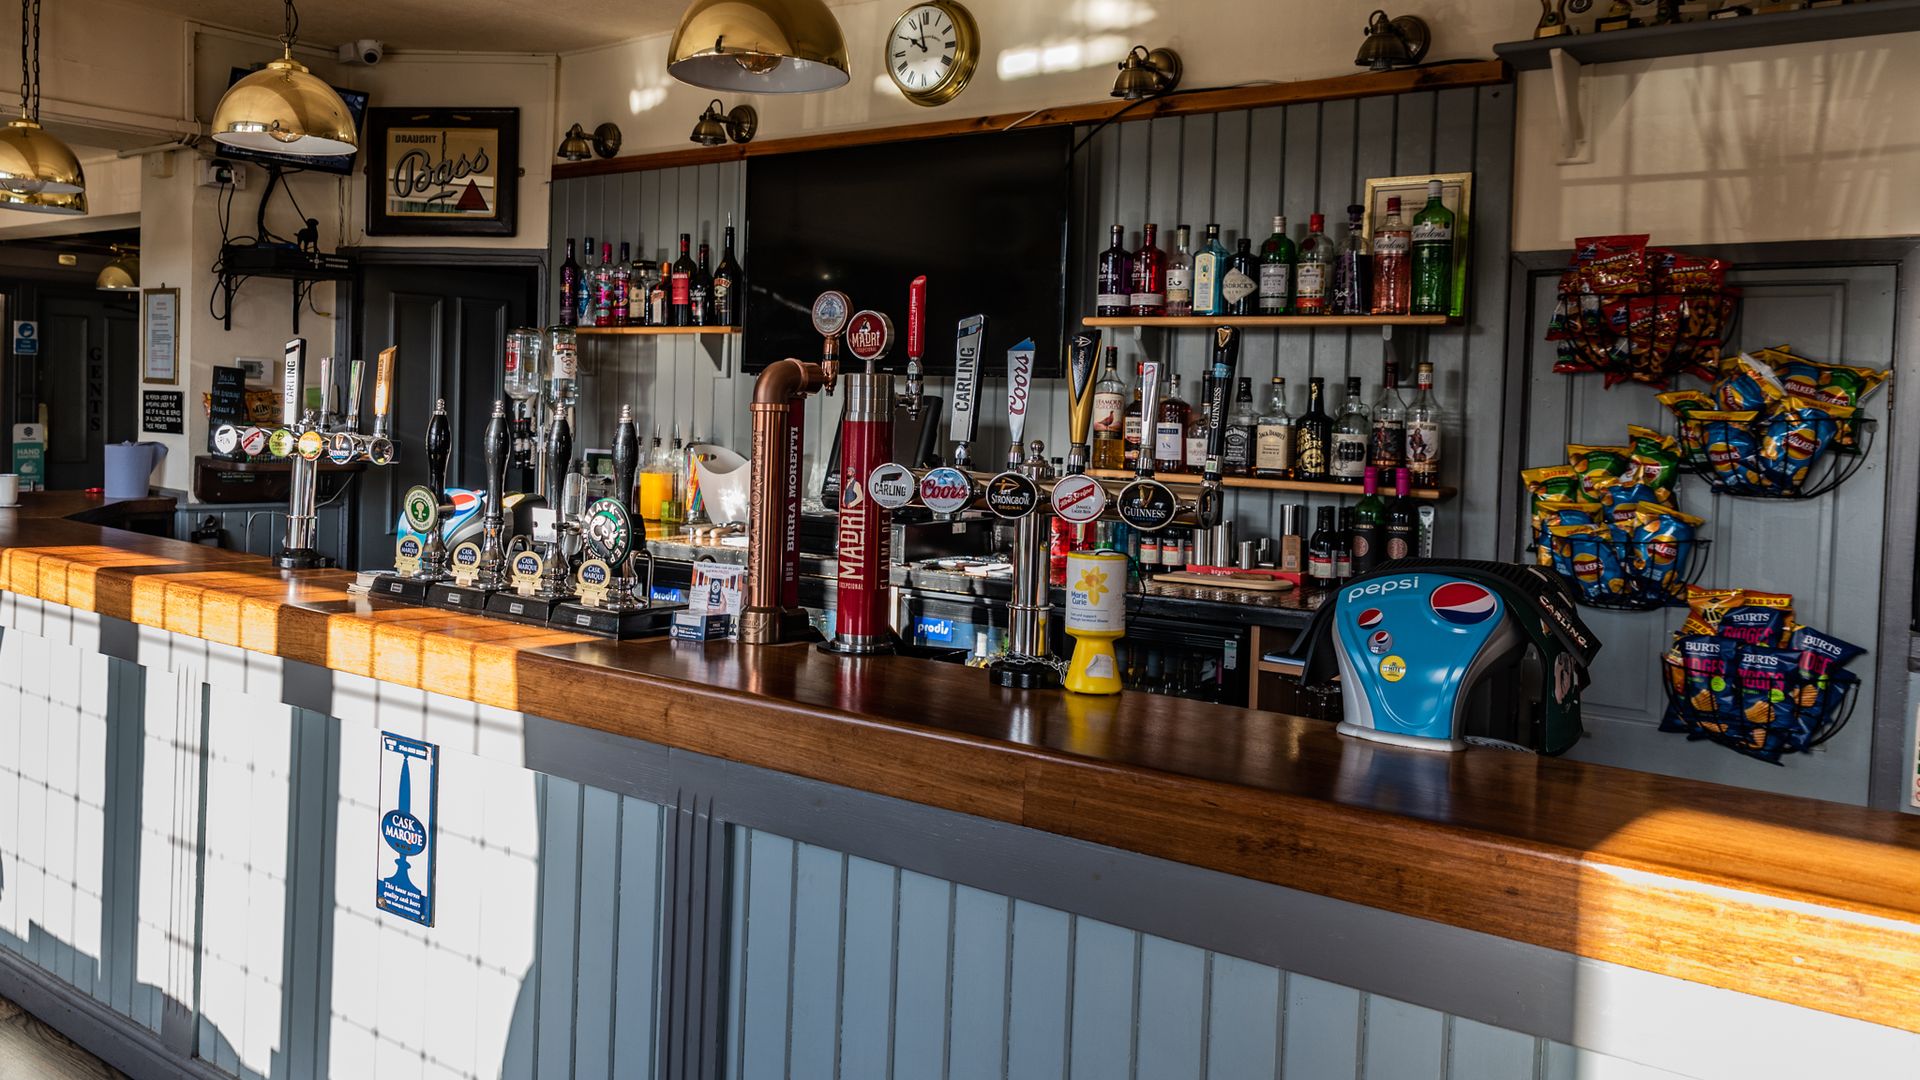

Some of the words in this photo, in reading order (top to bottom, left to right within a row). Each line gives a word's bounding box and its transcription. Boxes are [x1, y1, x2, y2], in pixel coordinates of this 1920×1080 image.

[396, 134, 437, 144] DRAUGHT
[394, 146, 489, 198] Bass
[90, 347, 102, 431] GENTS
[286, 360, 296, 404] CARLING
[954, 347, 976, 412] CARLING
[1009, 354, 1030, 416] Coors
[1210, 387, 1222, 430] GUINNESS
[788, 426, 798, 498] MORETTI
[874, 482, 906, 496] CARLING
[920, 480, 968, 498] Coors
[991, 493, 1030, 505] STRONGBOW
[1124, 506, 1167, 518] GUINNESS
[584, 501, 616, 524] BLACK
[610, 518, 627, 563] SHEEP
[787, 502, 796, 552] BIRRA
[1071, 590, 1088, 600] Marie
[1348, 576, 1419, 603] pepsi
[918, 620, 949, 634] prodis
[1540, 595, 1588, 648] CARLING
[1732, 612, 1770, 622] BURTS
[1685, 641, 1720, 653] BURTS
[1803, 634, 1842, 656] BURTS
[1742, 653, 1779, 666] BURTS
[392, 814, 414, 832] CASK
[385, 824, 423, 847] MARQUE
[384, 882, 394, 890] This
[384, 891, 399, 902] quality
